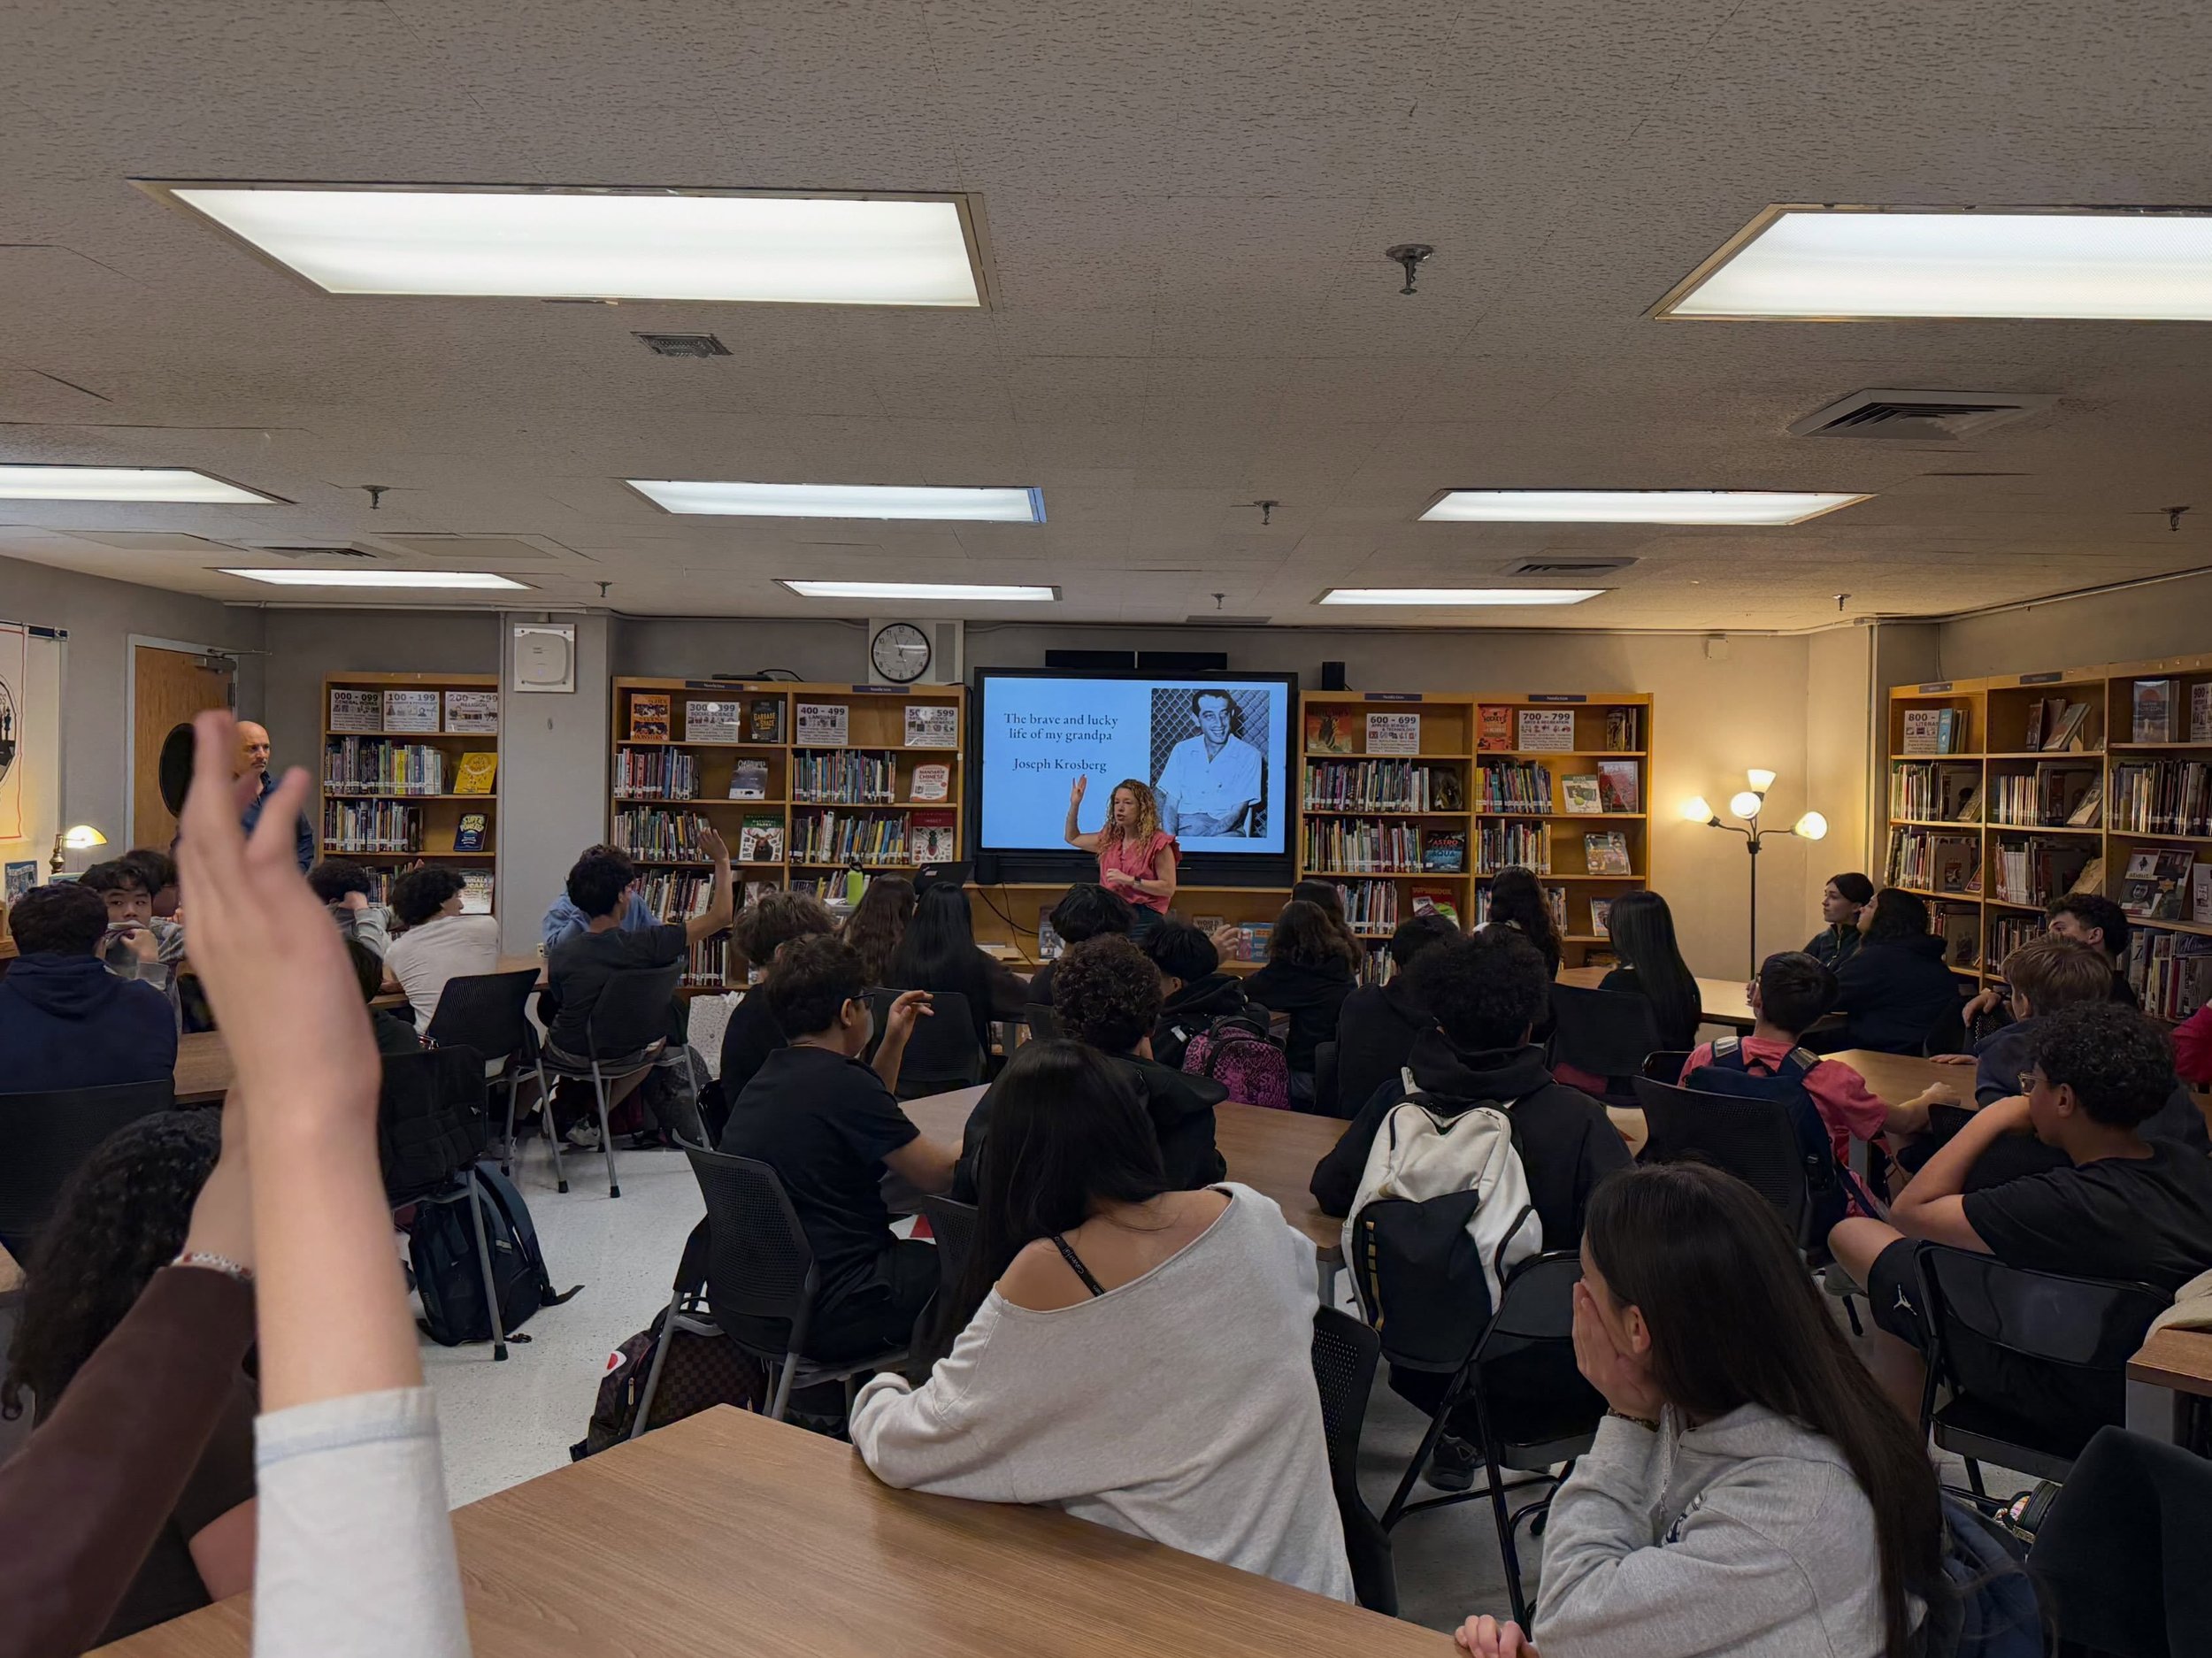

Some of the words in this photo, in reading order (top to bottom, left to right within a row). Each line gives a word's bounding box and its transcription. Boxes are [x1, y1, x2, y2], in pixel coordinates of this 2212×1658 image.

[1004, 713, 1026, 724] The
[1030, 713, 1061, 724] brave
[1063, 715, 1084, 725] and
[1088, 715, 1118, 729] lucky
[1009, 728, 1027, 739] life
[1030, 729, 1043, 739] of
[1046, 733, 1062, 743] my
[1065, 730, 1112, 743] grandpa
[1013, 758, 1051, 772] Joseph
[1055, 759, 1107, 774] Krosberg
